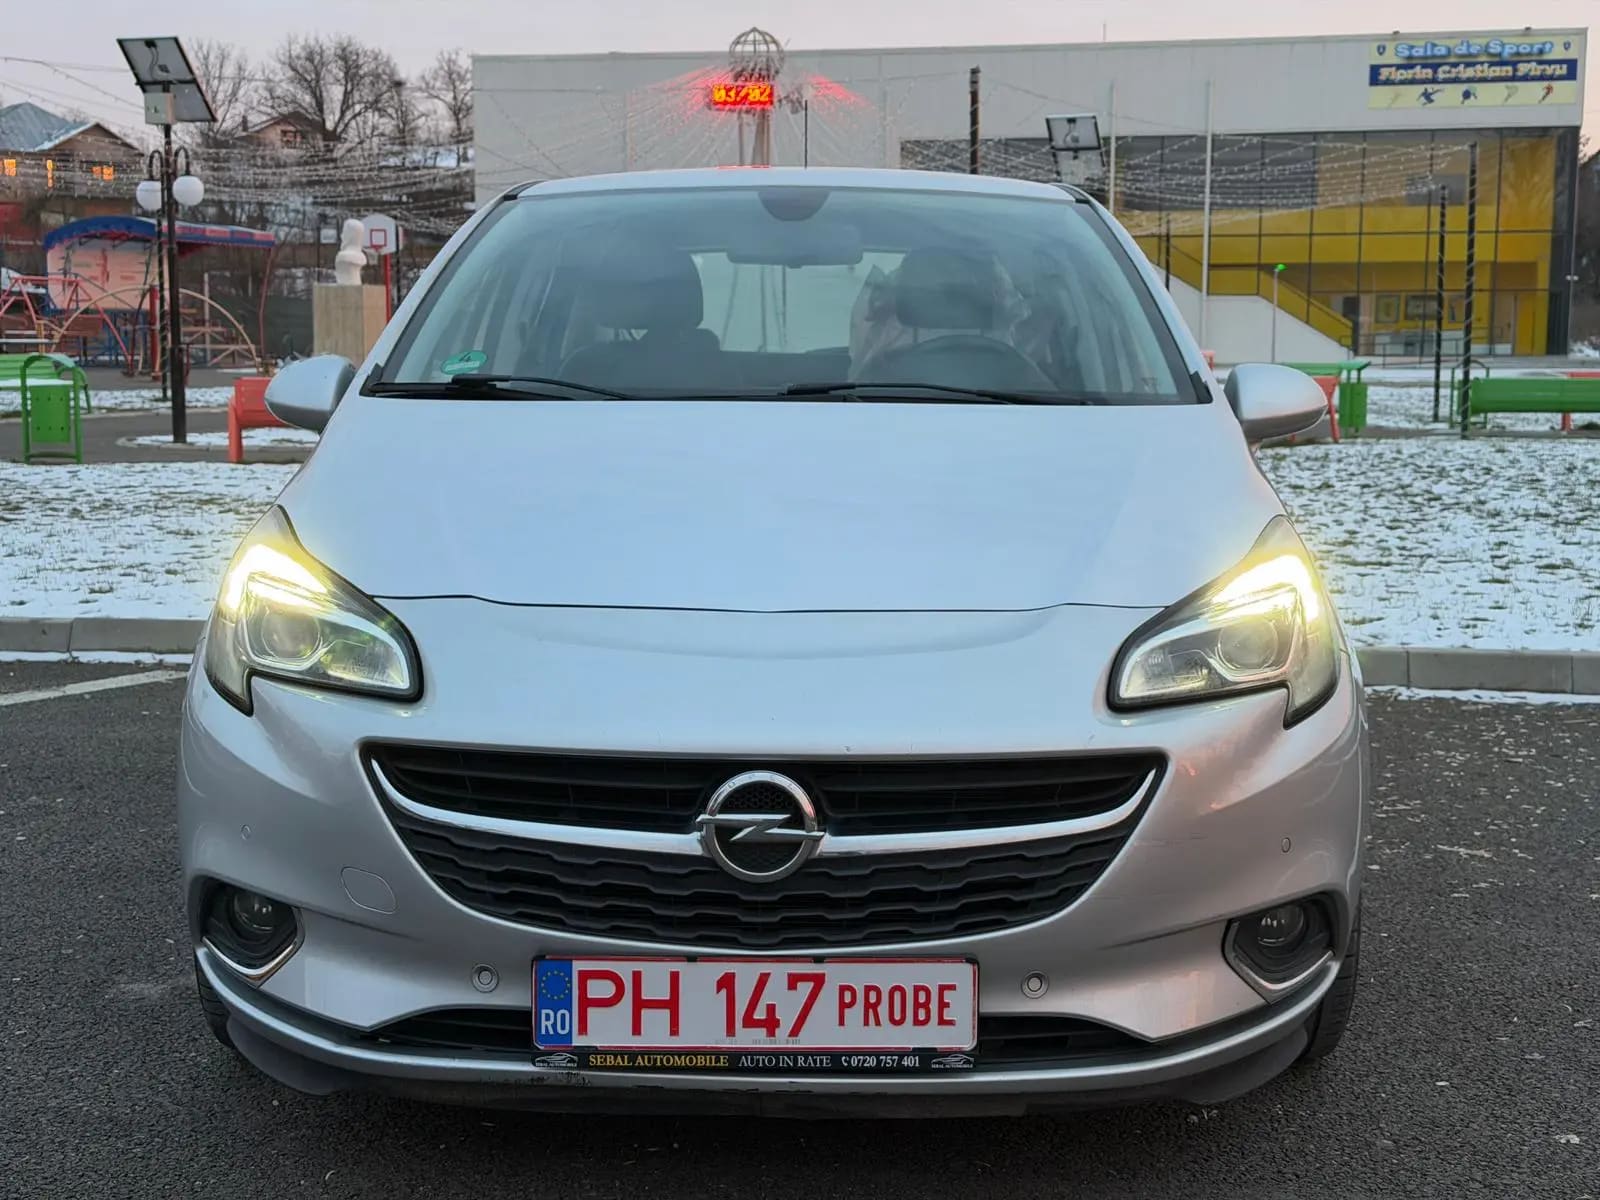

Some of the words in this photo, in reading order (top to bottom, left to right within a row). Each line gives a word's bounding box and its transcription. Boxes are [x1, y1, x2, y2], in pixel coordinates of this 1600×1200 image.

[1395, 42, 1449, 58] Sala
[1454, 41, 1482, 55] de
[1487, 39, 1553, 60] Sport
[1379, 64, 1432, 81] Florin
[1437, 62, 1512, 80] Cristian
[577, 969, 680, 1037] PH
[716, 971, 826, 1038] 147
[838, 983, 957, 1027] PROBE
[541, 1009, 570, 1035] RO
[589, 1055, 632, 1067] SEBAL
[635, 1055, 729, 1067] AUTOMOBILE
[738, 1055, 776, 1067] AUTO
[779, 1055, 793, 1067] IN
[797, 1055, 831, 1067] RATE
[851, 1055, 877, 1067] 0720
[880, 1055, 898, 1067] 757
[902, 1055, 919, 1067] 401
